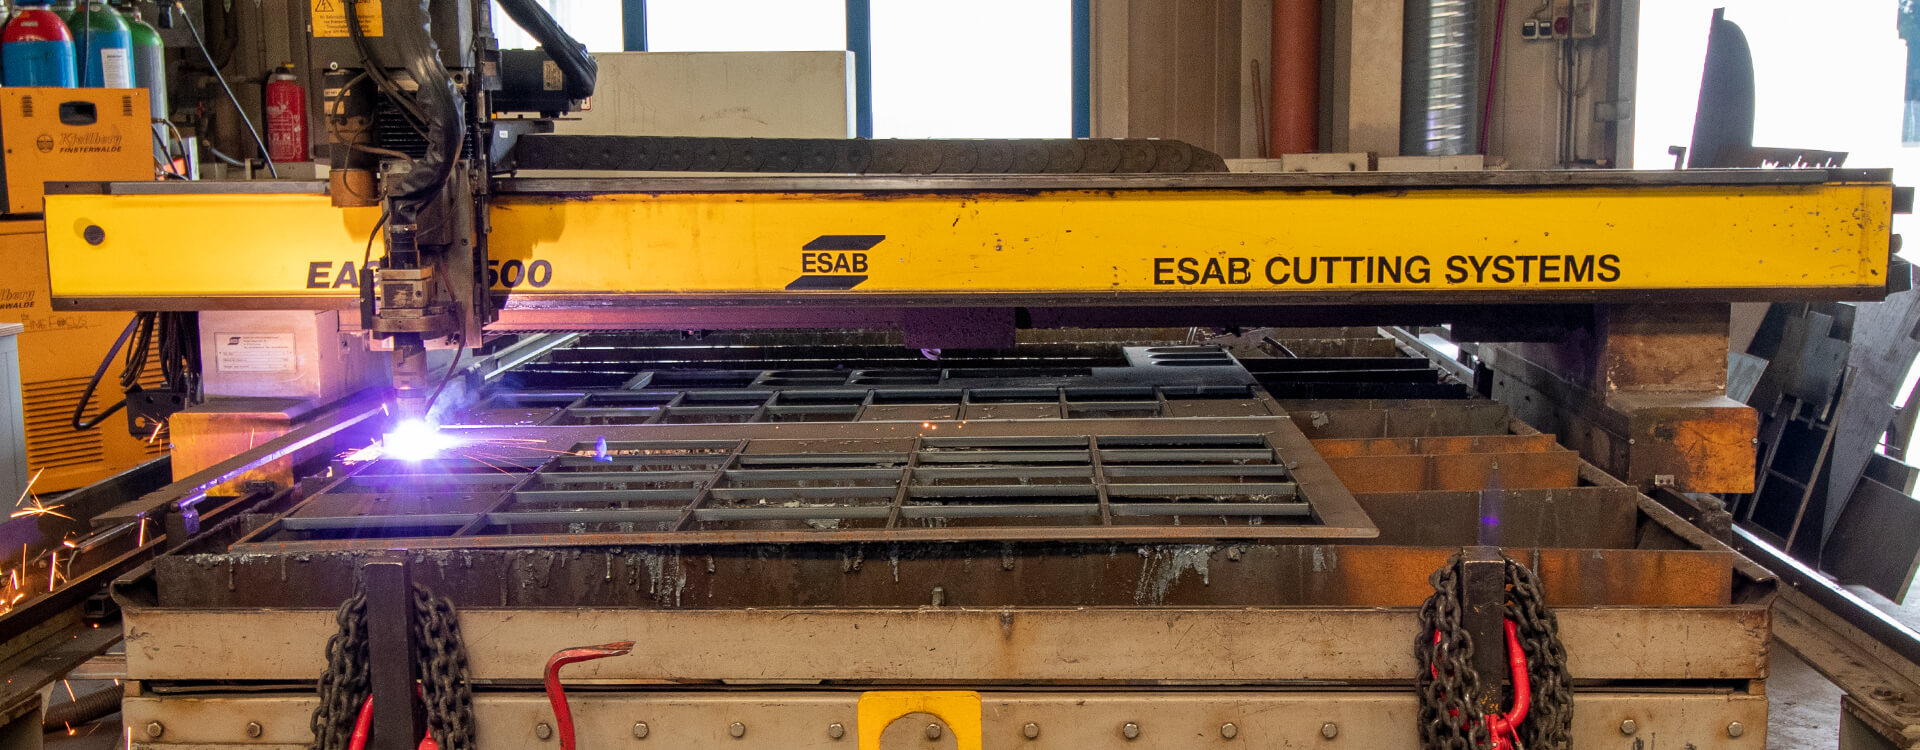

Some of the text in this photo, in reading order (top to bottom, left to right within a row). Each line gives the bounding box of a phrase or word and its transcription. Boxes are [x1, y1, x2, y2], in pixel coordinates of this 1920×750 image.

[802, 252, 869, 274] ESAB
[1153, 254, 1621, 285] ESAB CUTTING SYSTEMS
